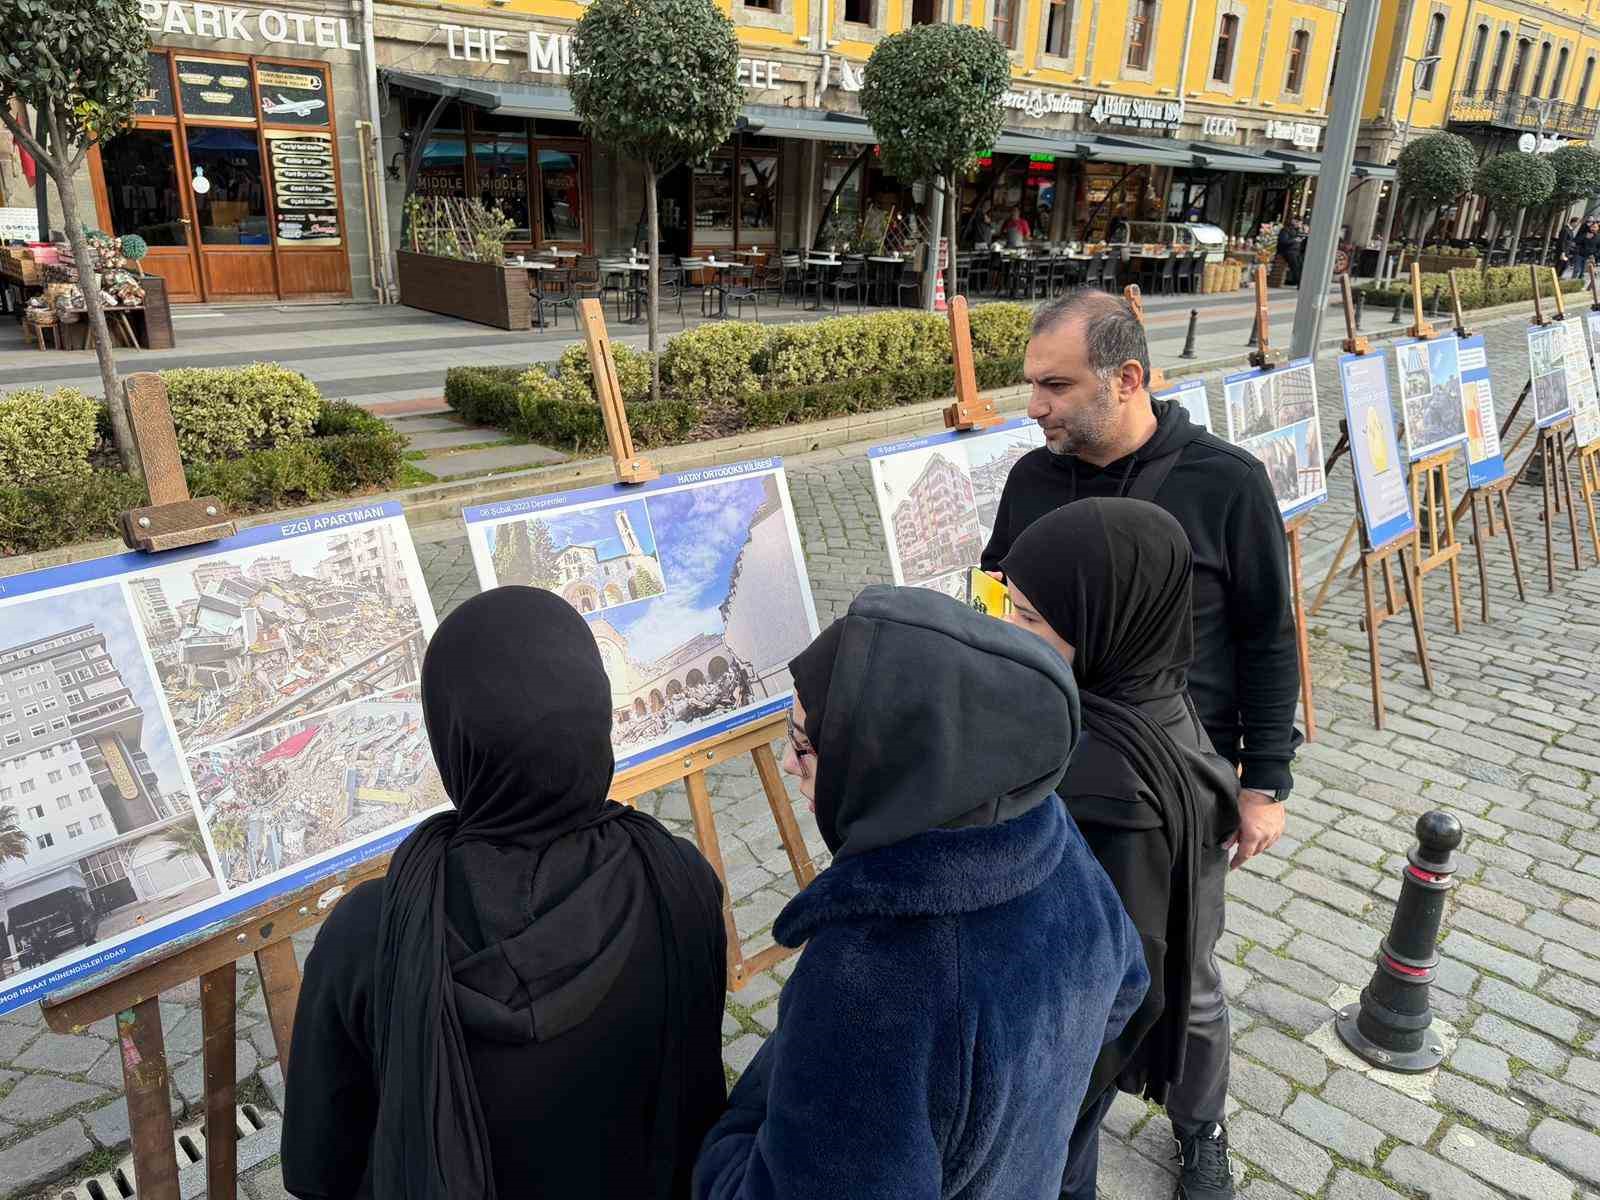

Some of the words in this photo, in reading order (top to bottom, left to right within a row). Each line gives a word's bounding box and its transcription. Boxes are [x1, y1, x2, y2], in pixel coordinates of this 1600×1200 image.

[139, 0, 253, 41] PARK
[258, 9, 360, 50] OTEL
[440, 23, 510, 65] THE
[678, 473, 702, 484] HATAY
[703, 464, 744, 479] ORTODOKS
[314, 505, 385, 530] APARTMANI
[104, 947, 127, 961] ODASI
